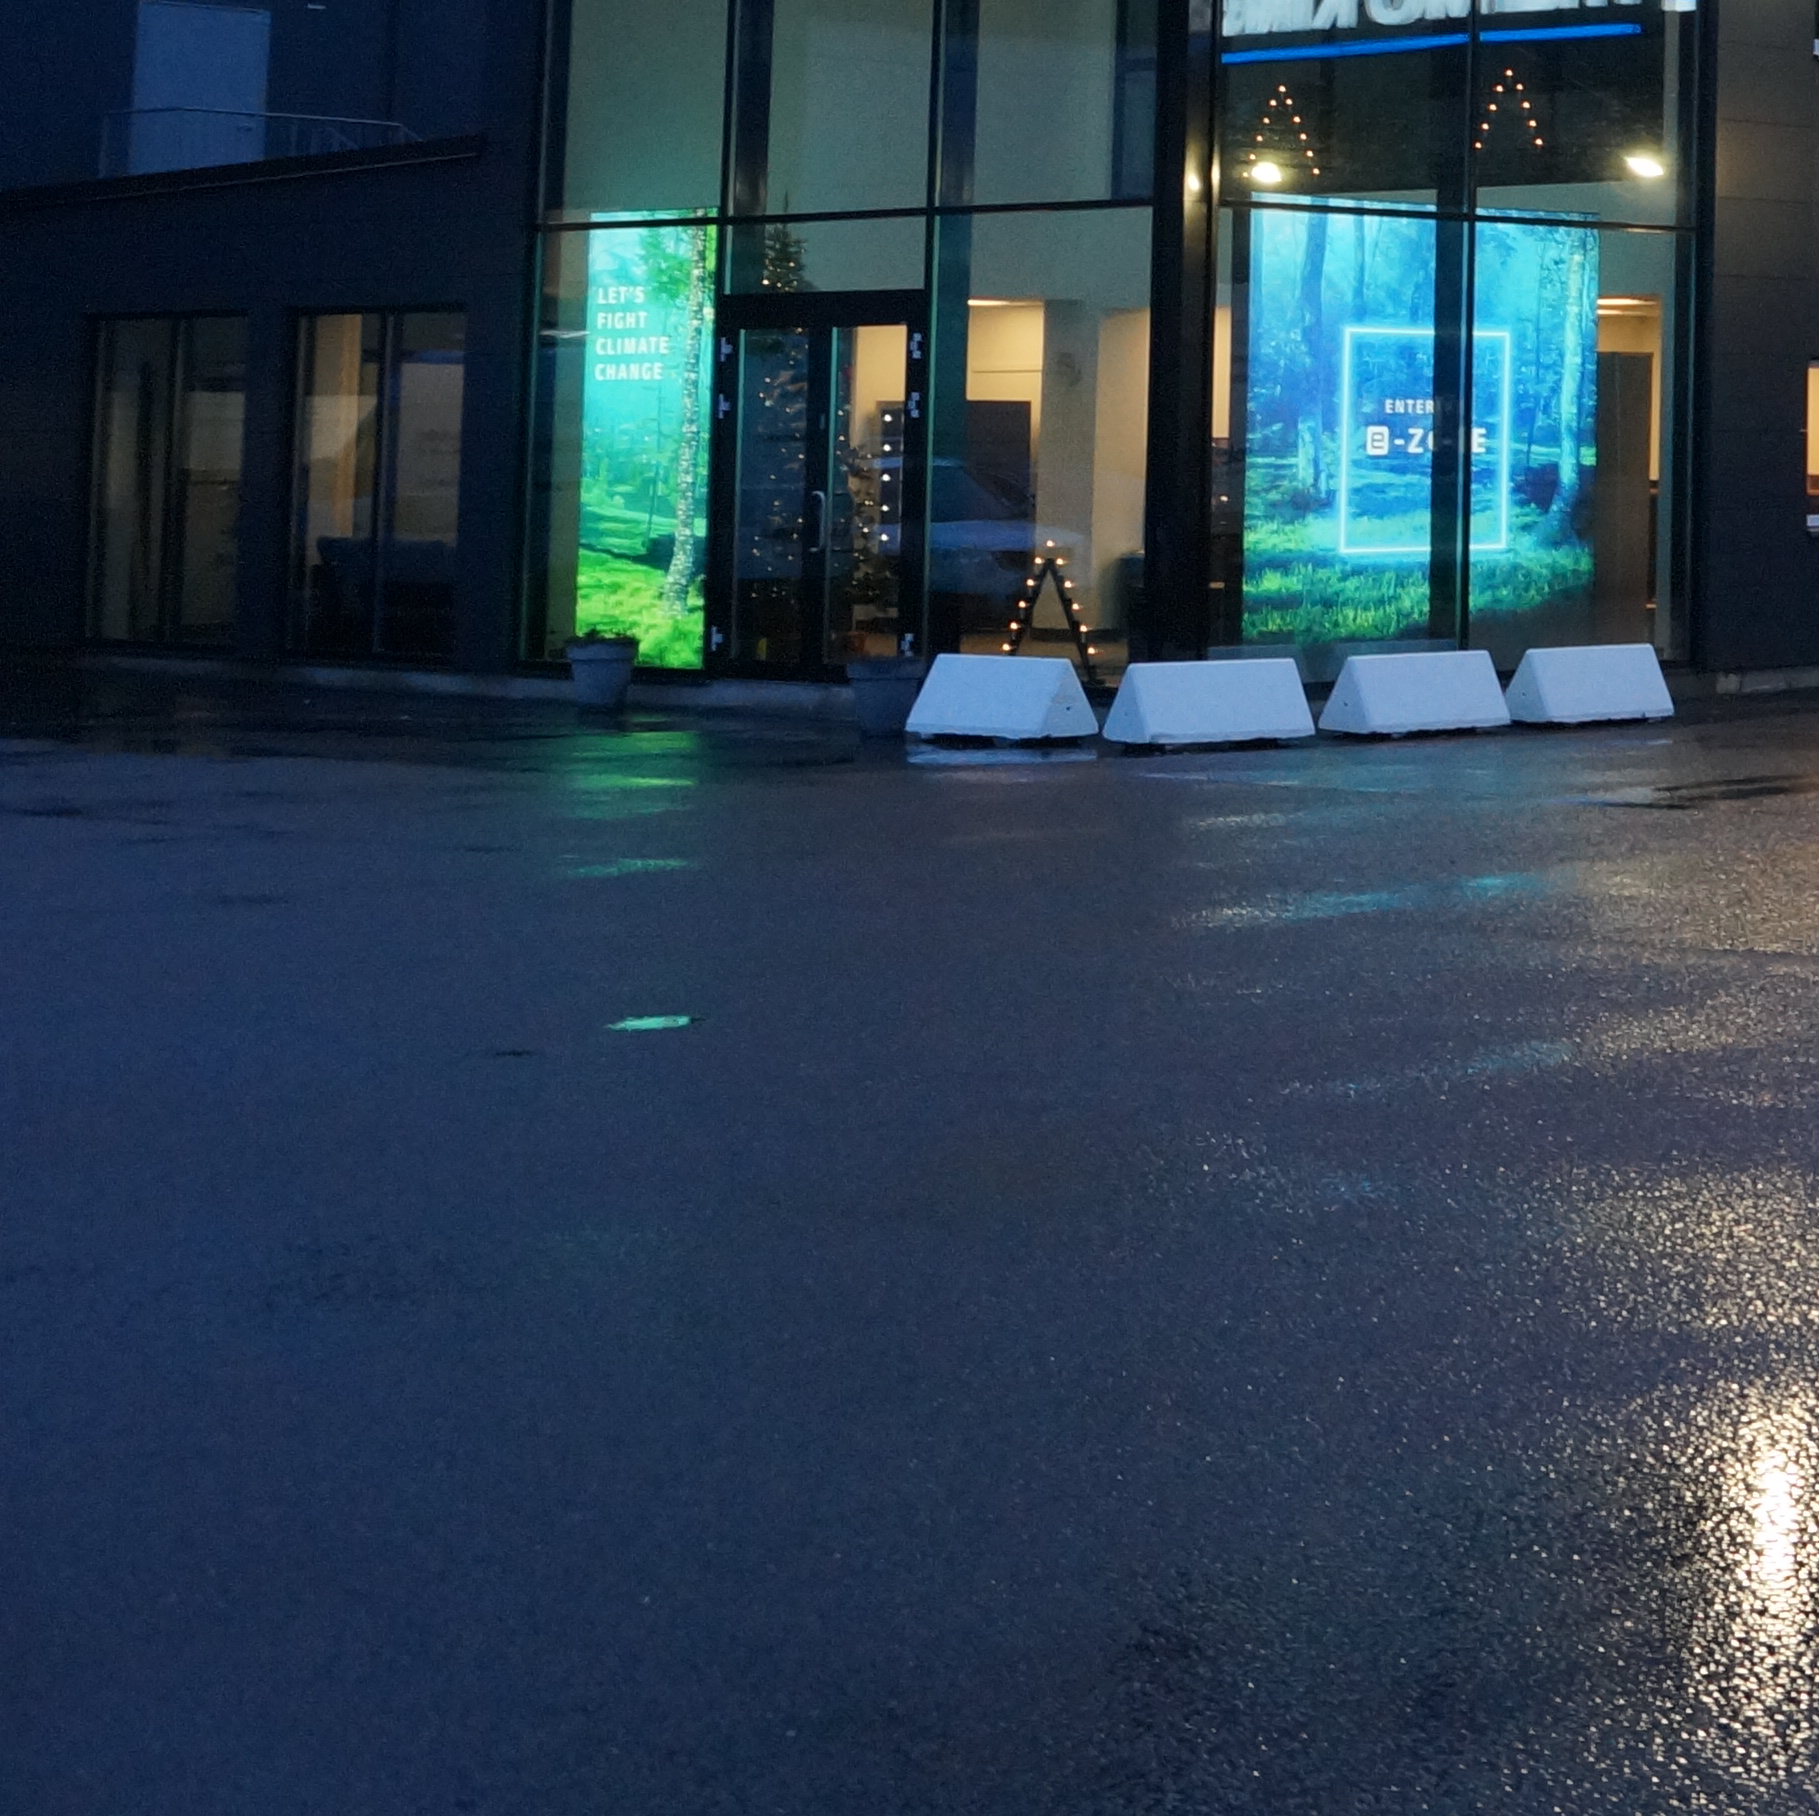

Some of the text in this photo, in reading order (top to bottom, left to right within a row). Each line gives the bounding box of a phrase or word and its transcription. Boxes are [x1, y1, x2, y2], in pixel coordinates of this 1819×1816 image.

[596, 285, 645, 305] LET'S
[596, 311, 648, 330] FIGHT
[595, 335, 670, 356] CLIMATE
[594, 361, 664, 382] CHANGE
[1384, 398, 1435, 415] ENTER
